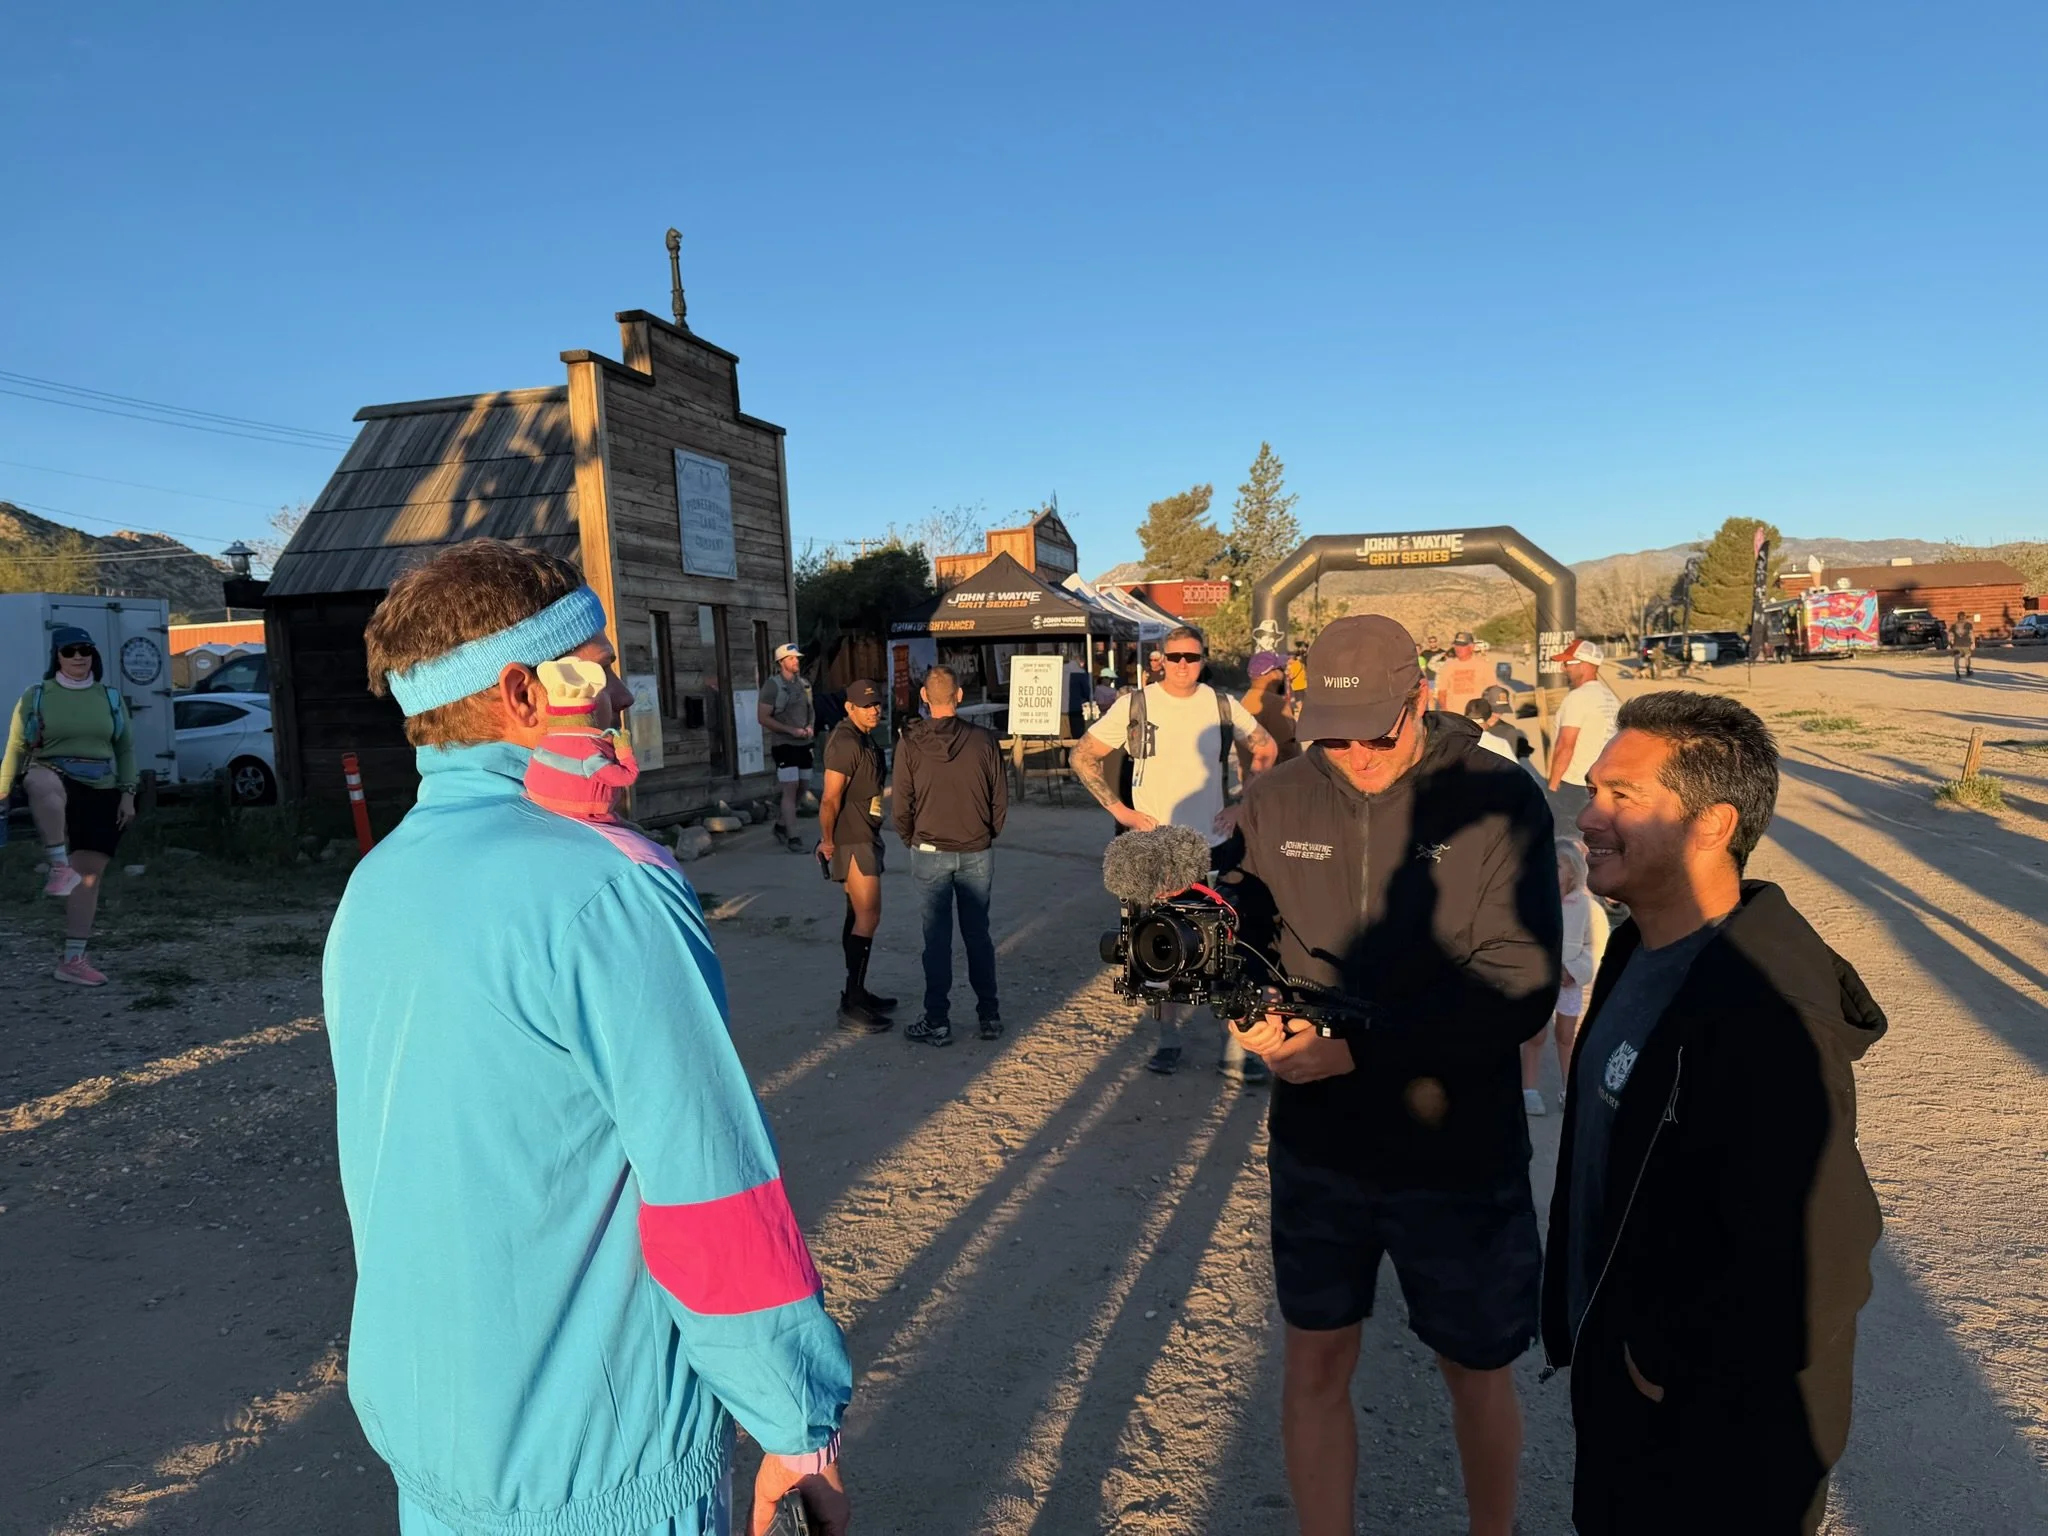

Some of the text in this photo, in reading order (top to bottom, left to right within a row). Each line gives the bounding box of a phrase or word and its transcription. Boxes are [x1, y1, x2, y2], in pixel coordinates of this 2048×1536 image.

[1356, 533, 1464, 556] JOHN WAYNE
[1368, 550, 1451, 565] GRIT SERIES
[947, 591, 1042, 604] JOHN WAYNE
[957, 600, 1028, 609] GRIT SERIES
[1539, 631, 1562, 645] RUN
[1018, 686, 1053, 696] RED DOG
[1017, 697, 1053, 708] SALOON
[1280, 841, 1334, 856] JOHN WAYNE
[1286, 849, 1325, 861] GRIT SERIES
